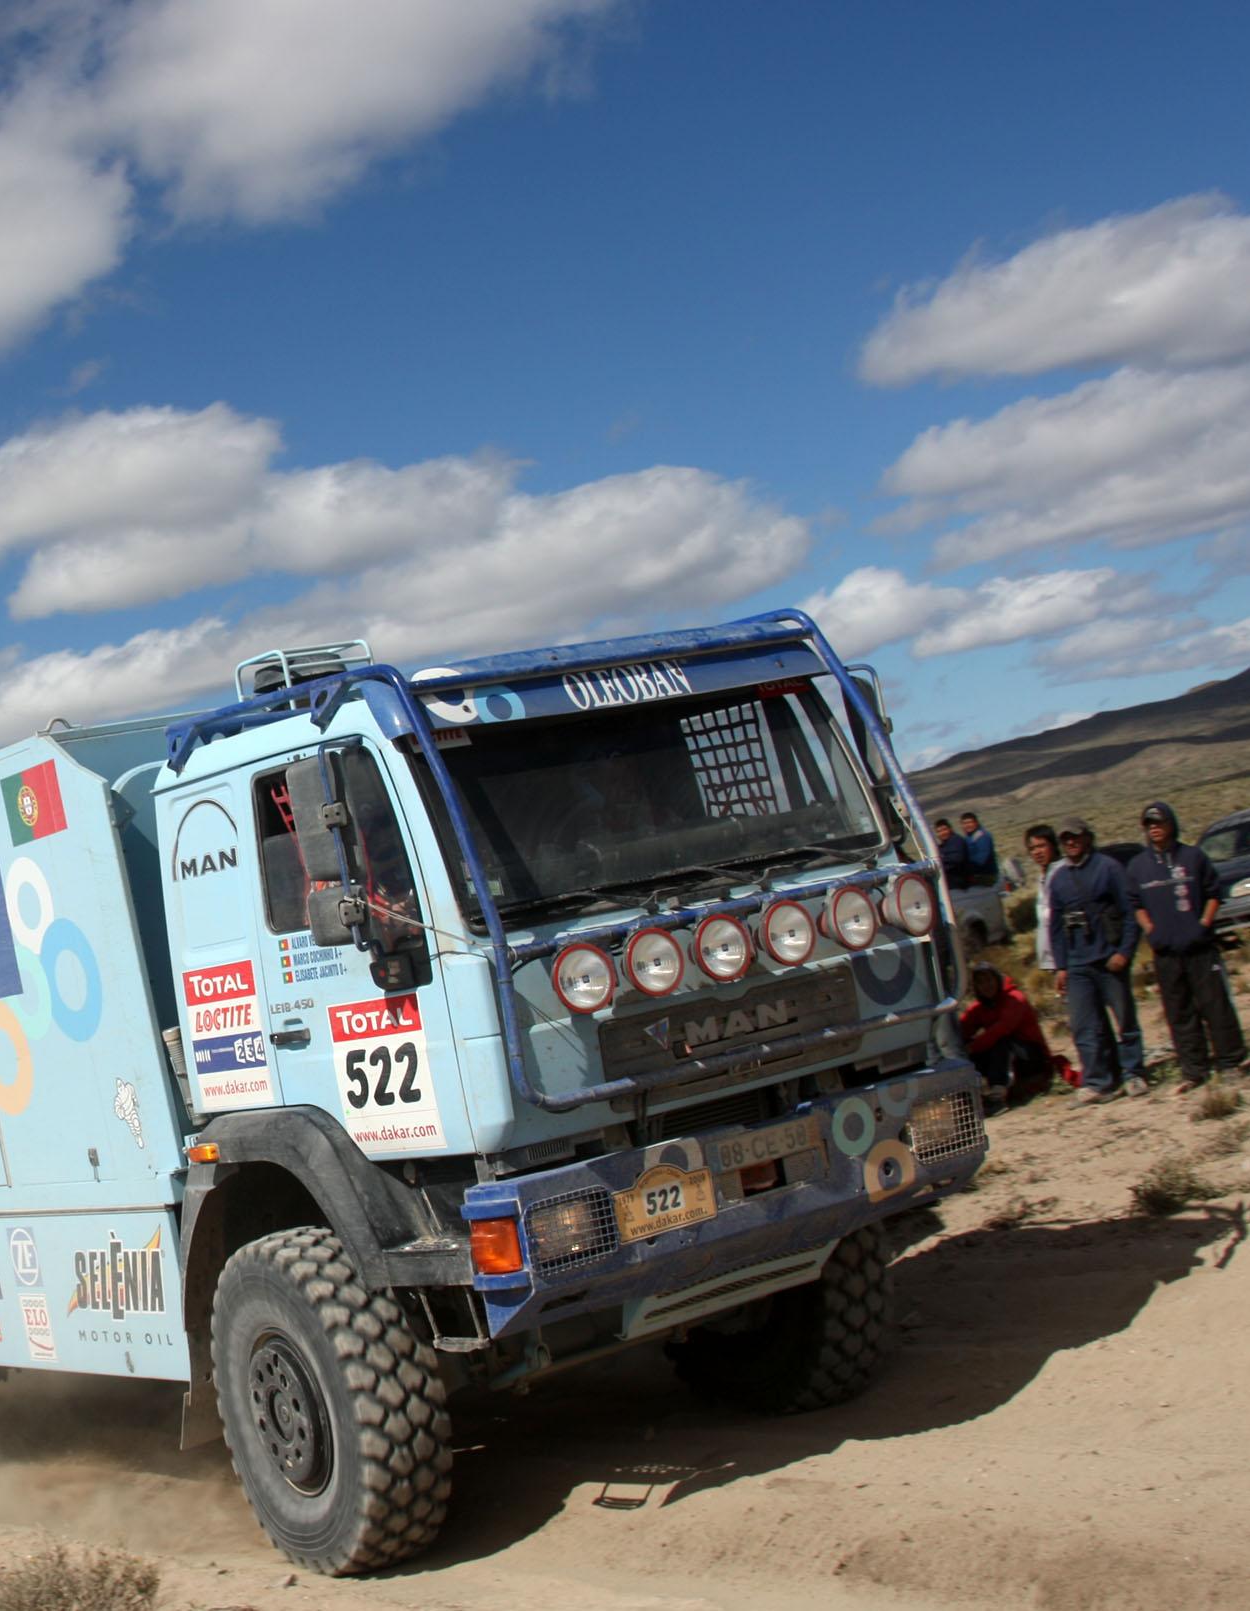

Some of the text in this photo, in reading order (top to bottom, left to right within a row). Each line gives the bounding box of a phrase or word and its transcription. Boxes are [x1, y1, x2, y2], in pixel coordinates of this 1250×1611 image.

[180, 847, 237, 880] MAN
[189, 973, 249, 998] TOTAL
[195, 1003, 253, 1033] LOCTITE
[335, 1006, 414, 1035] TOTAL
[684, 1000, 790, 1044] MAN
[203, 1079, 269, 1098] www.dakar.com
[346, 1042, 422, 1109] 522
[354, 1124, 438, 1143] www.dakar.com
[646, 1185, 682, 1216] 522
[24, 1308, 48, 1327] ELO
[78, 1330, 174, 1347] MOTOR OIL
